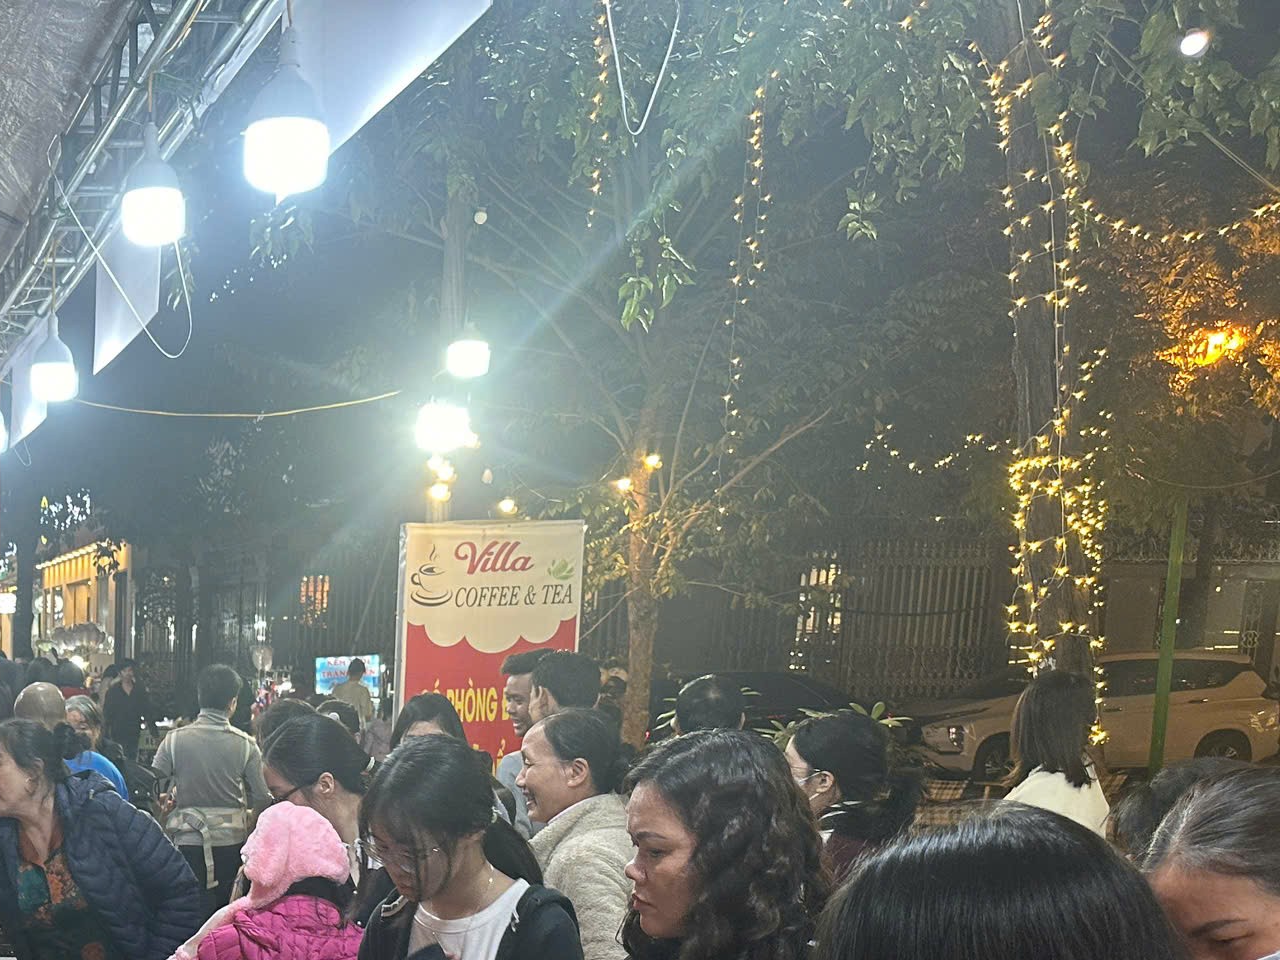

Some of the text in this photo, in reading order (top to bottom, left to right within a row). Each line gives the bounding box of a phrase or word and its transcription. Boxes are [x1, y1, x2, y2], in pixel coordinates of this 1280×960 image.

[454, 540, 535, 576] Villa
[455, 584, 573, 608] COFFEE & TEA
